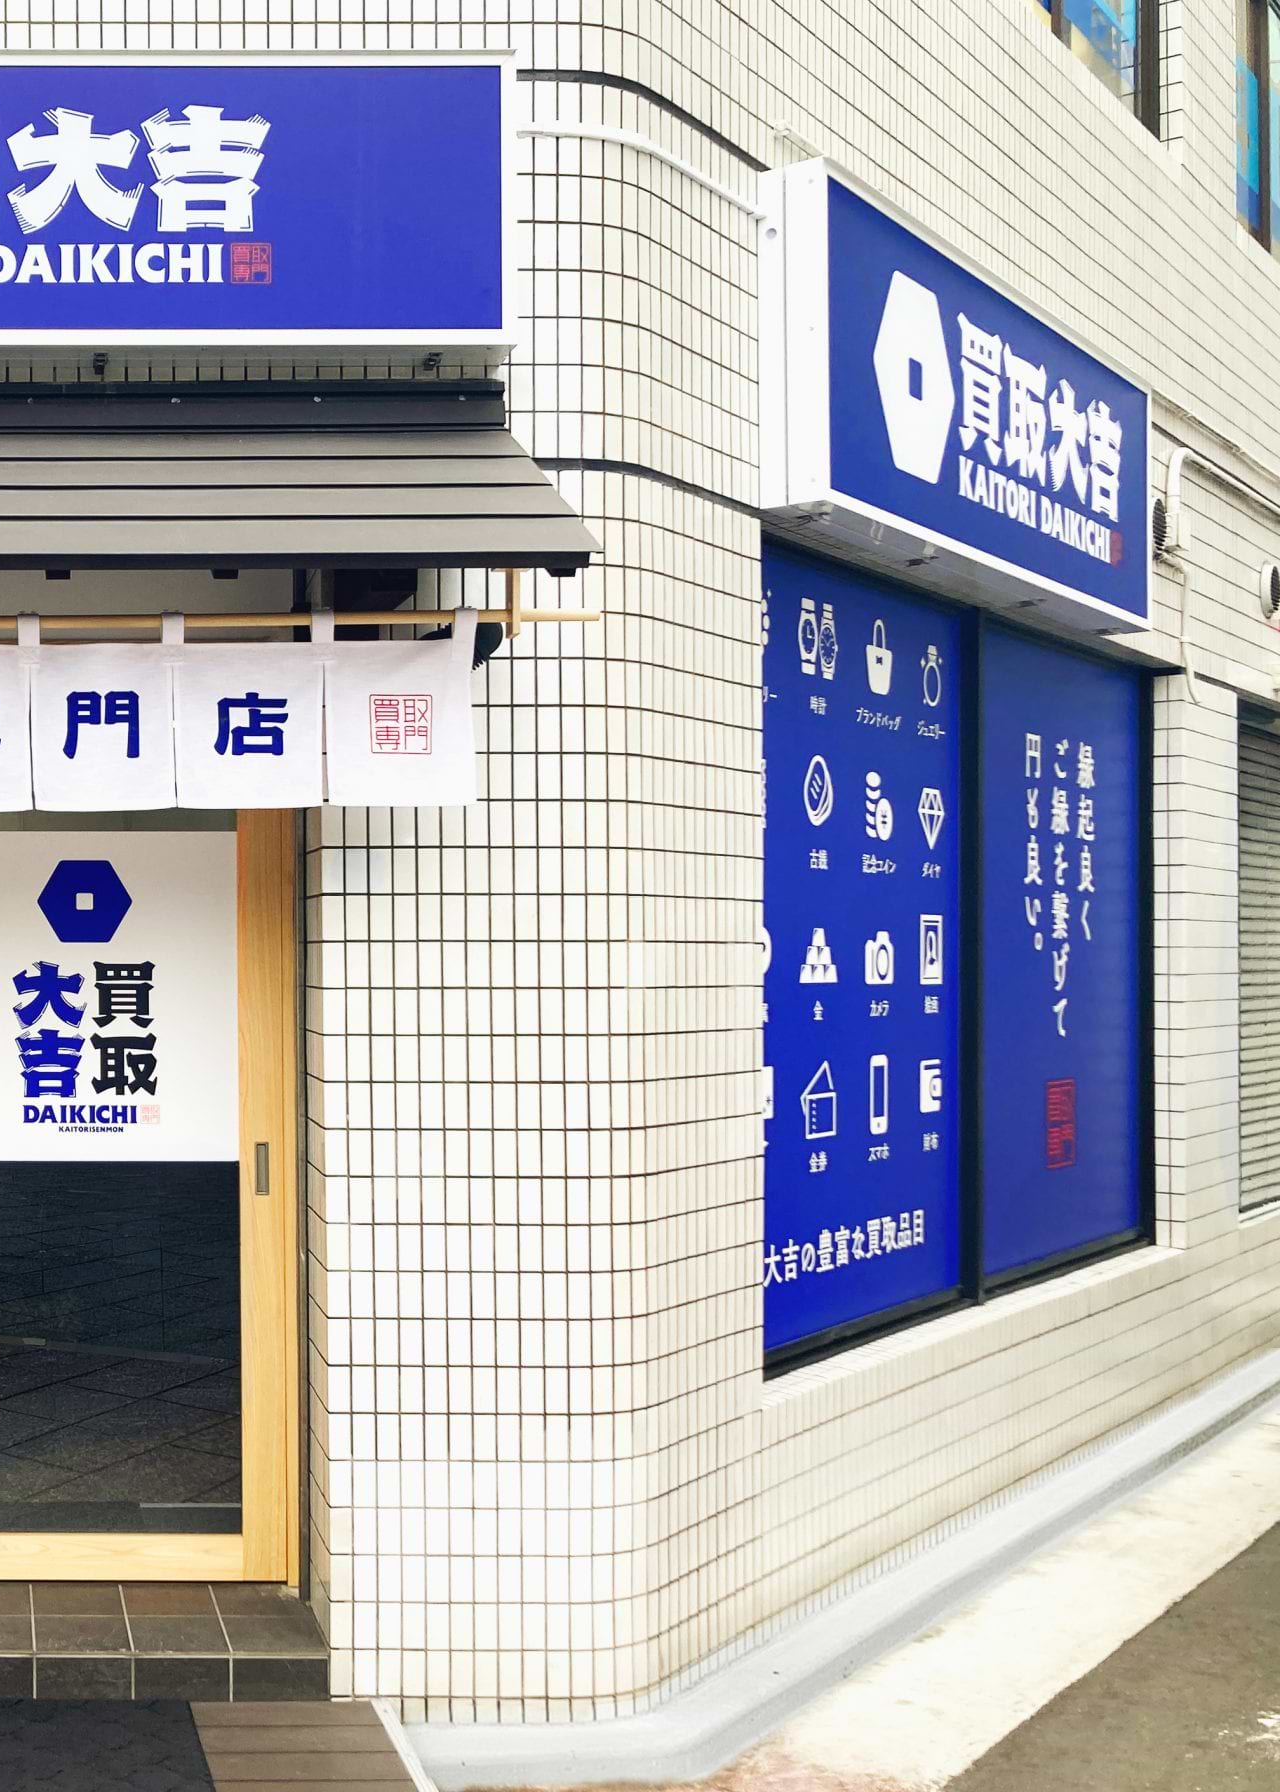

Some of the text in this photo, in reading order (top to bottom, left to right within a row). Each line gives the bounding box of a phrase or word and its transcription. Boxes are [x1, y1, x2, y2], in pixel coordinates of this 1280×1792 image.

[956, 312, 1123, 523] 買取大吉
[958, 454, 1037, 529] KAITORI
[1041, 493, 1112, 564] DAIKICHI
[856, 707, 902, 730] ブランドバッグ
[1076, 742, 1096, 940] 縁起良く
[12, 960, 88, 1098] 大吉
[90, 961, 158, 1096] 買取
[23, 1105, 137, 1124] DAIKICHI
[763, 1209, 925, 1288] 大吉の豊富な買取品目
